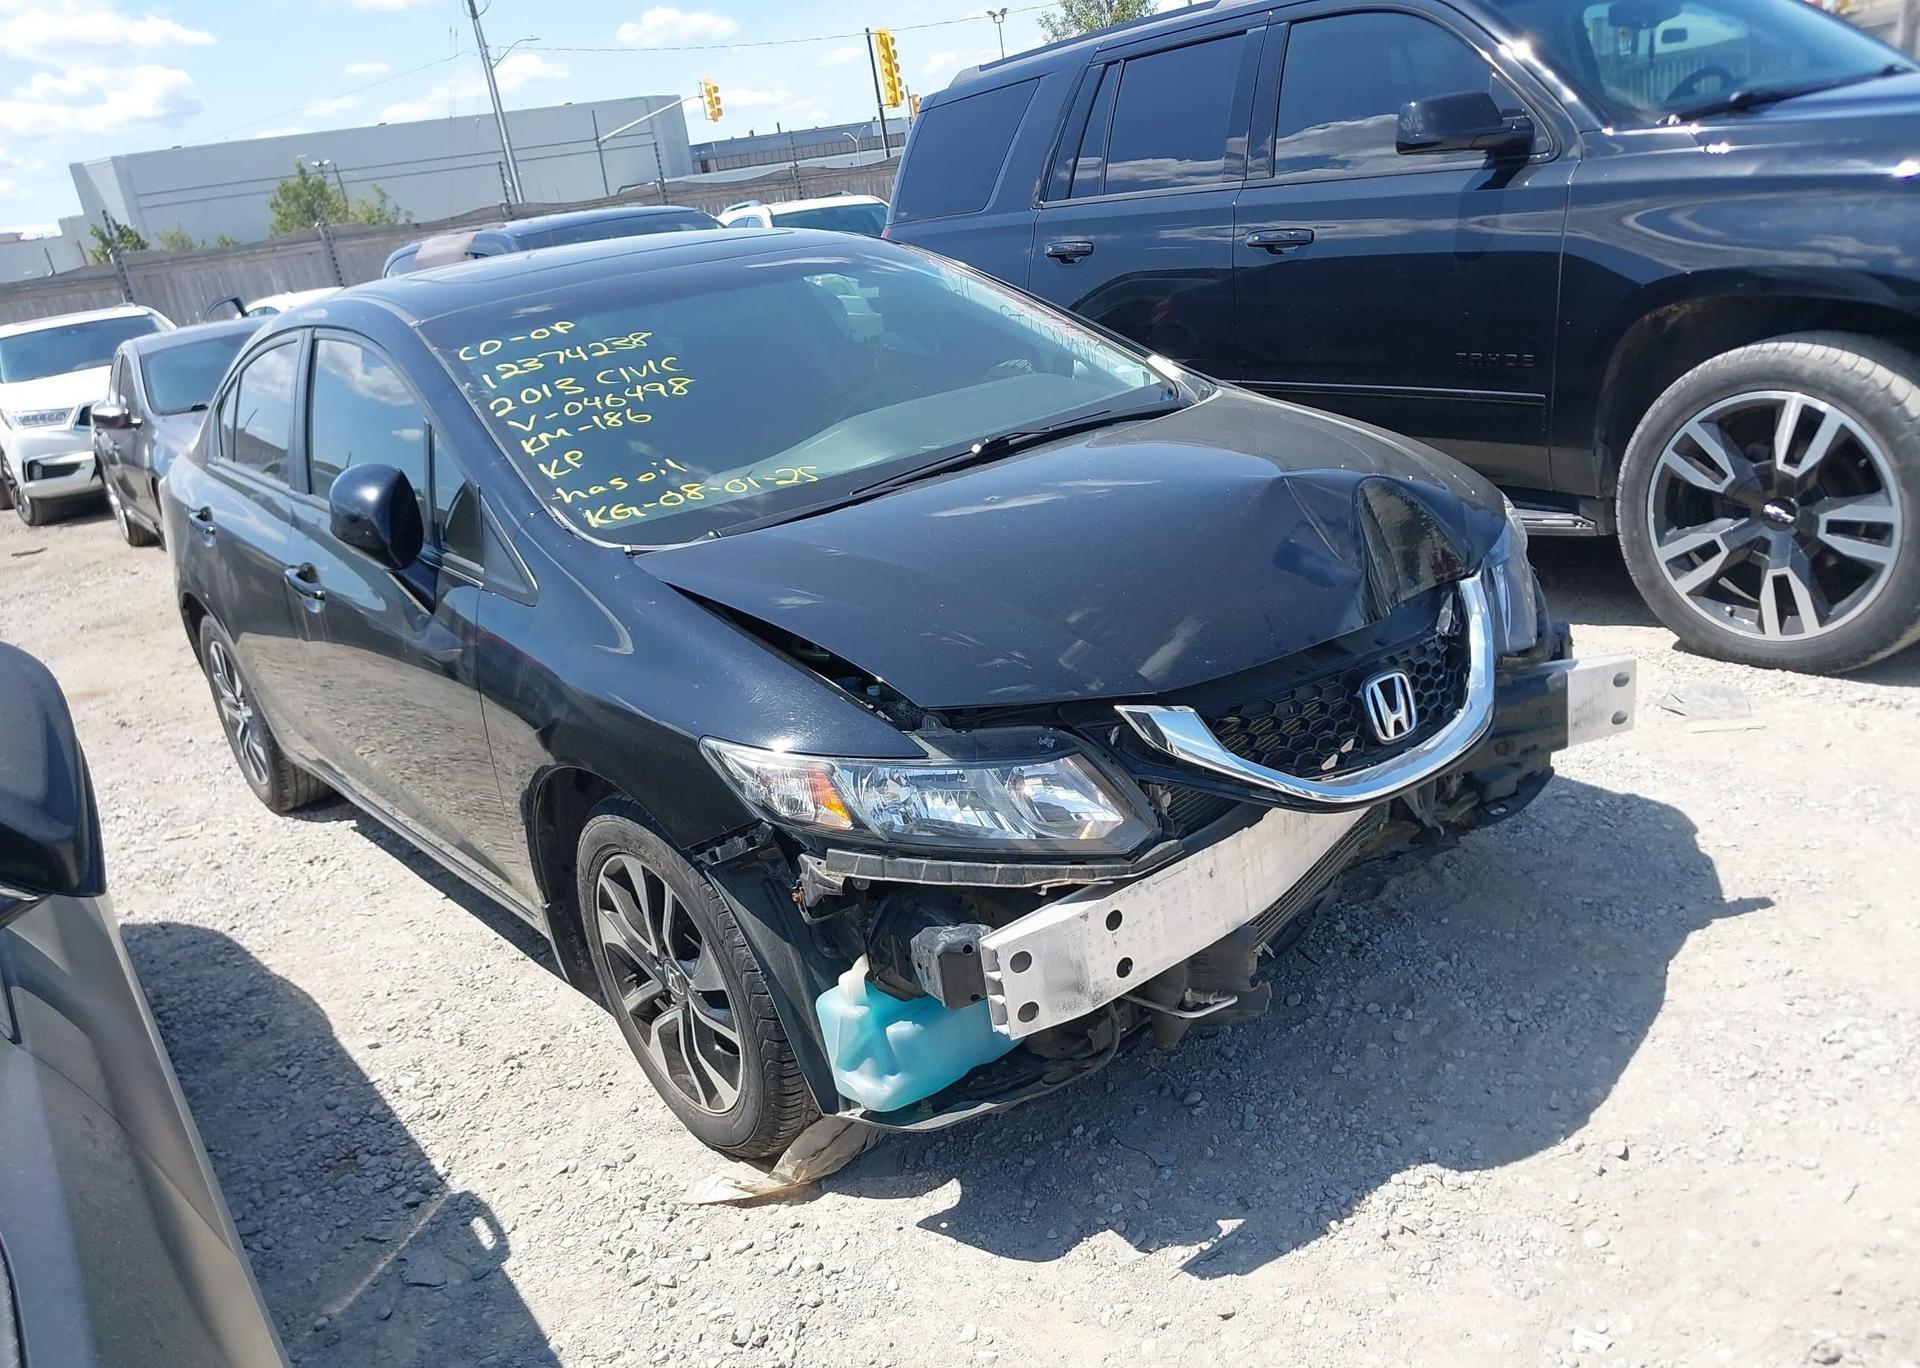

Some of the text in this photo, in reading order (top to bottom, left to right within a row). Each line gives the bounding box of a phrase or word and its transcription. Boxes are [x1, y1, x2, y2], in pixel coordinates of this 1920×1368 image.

[458, 321, 576, 361] CO-OP
[482, 332, 653, 389] 12374238
[489, 356, 684, 417] 2013 CIVIC
[507, 376, 698, 432] V-046498
[520, 408, 652, 456] KM-186
[538, 450, 584, 479] KP
[554, 458, 687, 504] has oil
